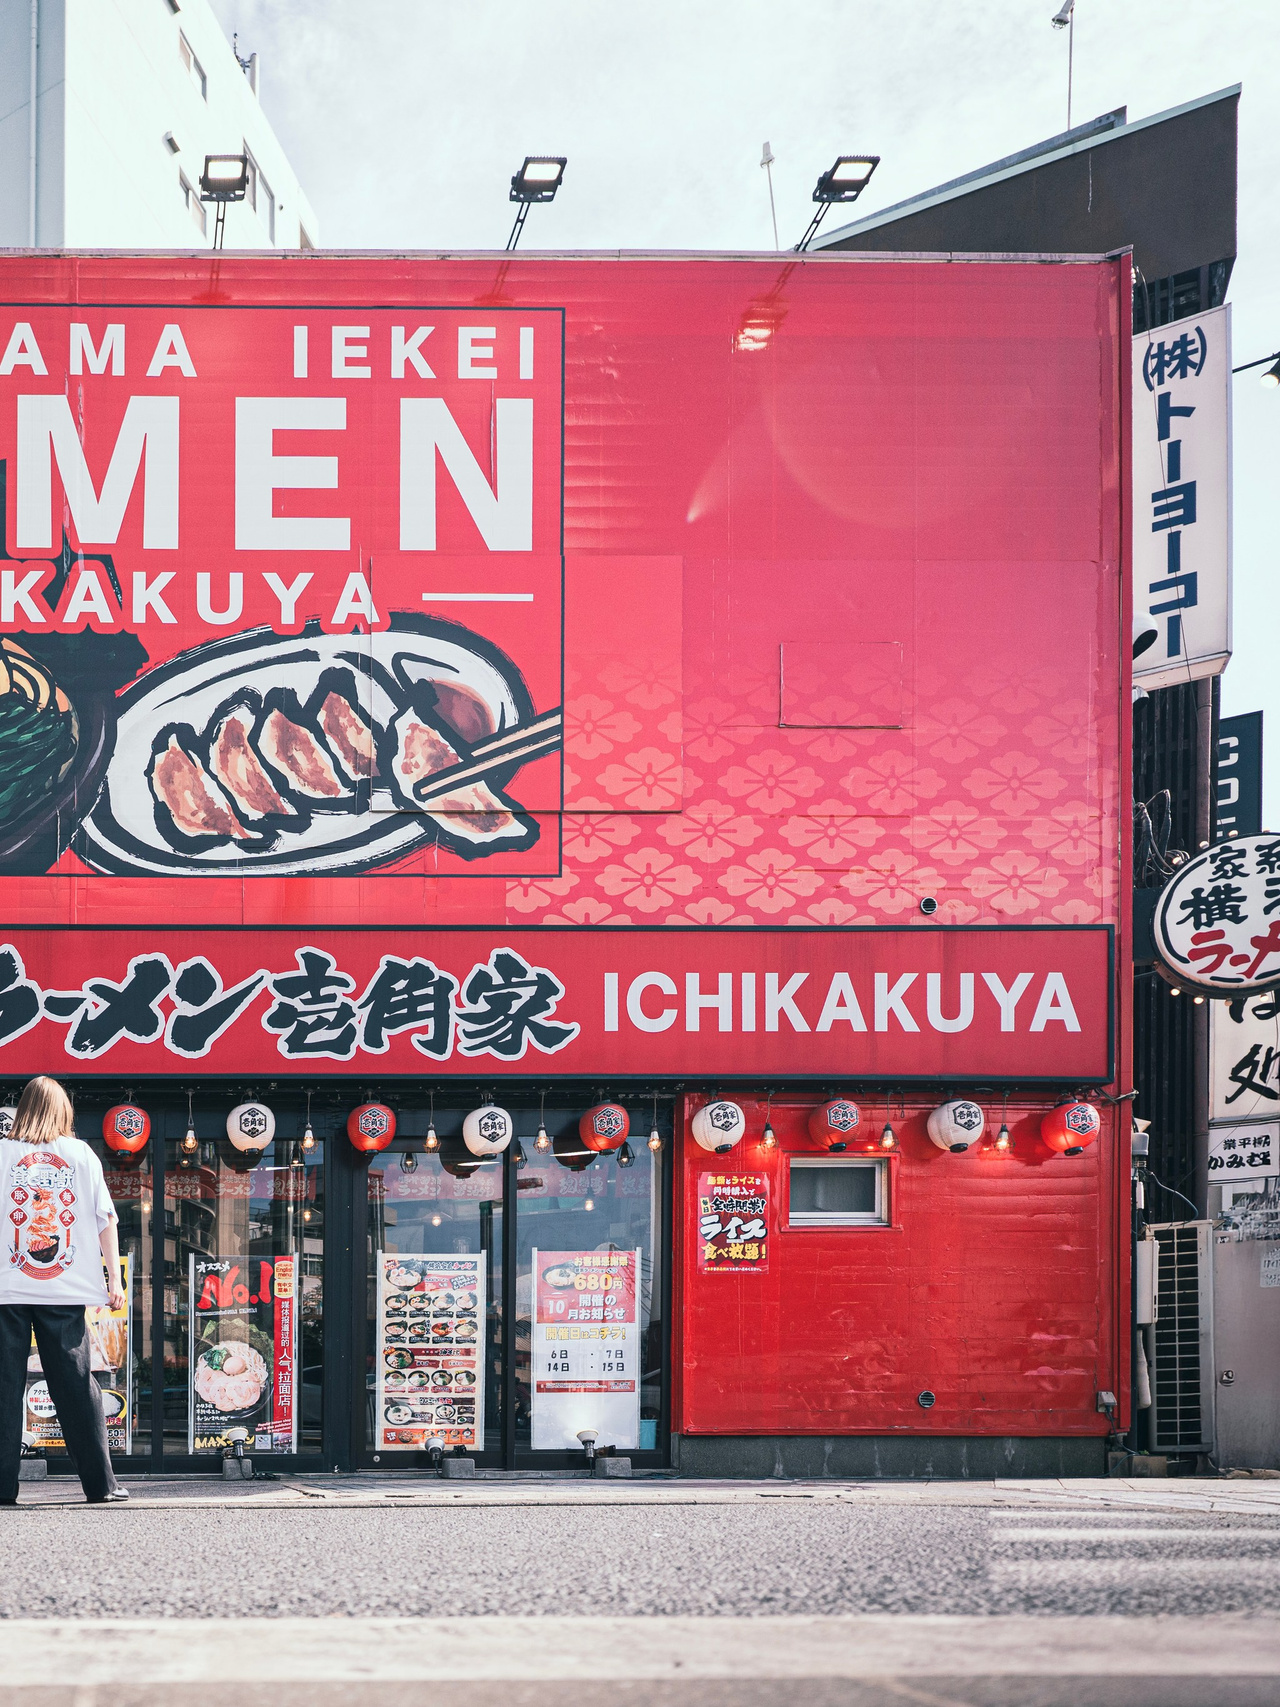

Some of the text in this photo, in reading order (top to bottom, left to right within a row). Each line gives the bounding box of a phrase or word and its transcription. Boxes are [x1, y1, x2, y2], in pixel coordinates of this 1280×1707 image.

[294, 325, 534, 379] IEKEI
[605, 971, 1082, 1033] ICHIKAKUYA
[714, 1111, 737, 1122] 壱角家
[832, 1110, 856, 1120] 壱角家
[118, 1118, 141, 1129] 壱角家
[242, 1117, 265, 1128] 壱角家
[362, 1117, 385, 1129] 壱角家
[481, 1121, 504, 1132] 壱角家
[597, 1117, 621, 1129] 壱角家
[700, 1214, 767, 1241] ライス
[196, 1260, 231, 1273] オススメ
[196, 1261, 274, 1310] No.1
[574, 1274, 624, 1291] 680円
[548, 1300, 566, 1314] 10
[579, 1294, 617, 1307] 開催の
[546, 1327, 626, 1340] 開催日はコチラ!
